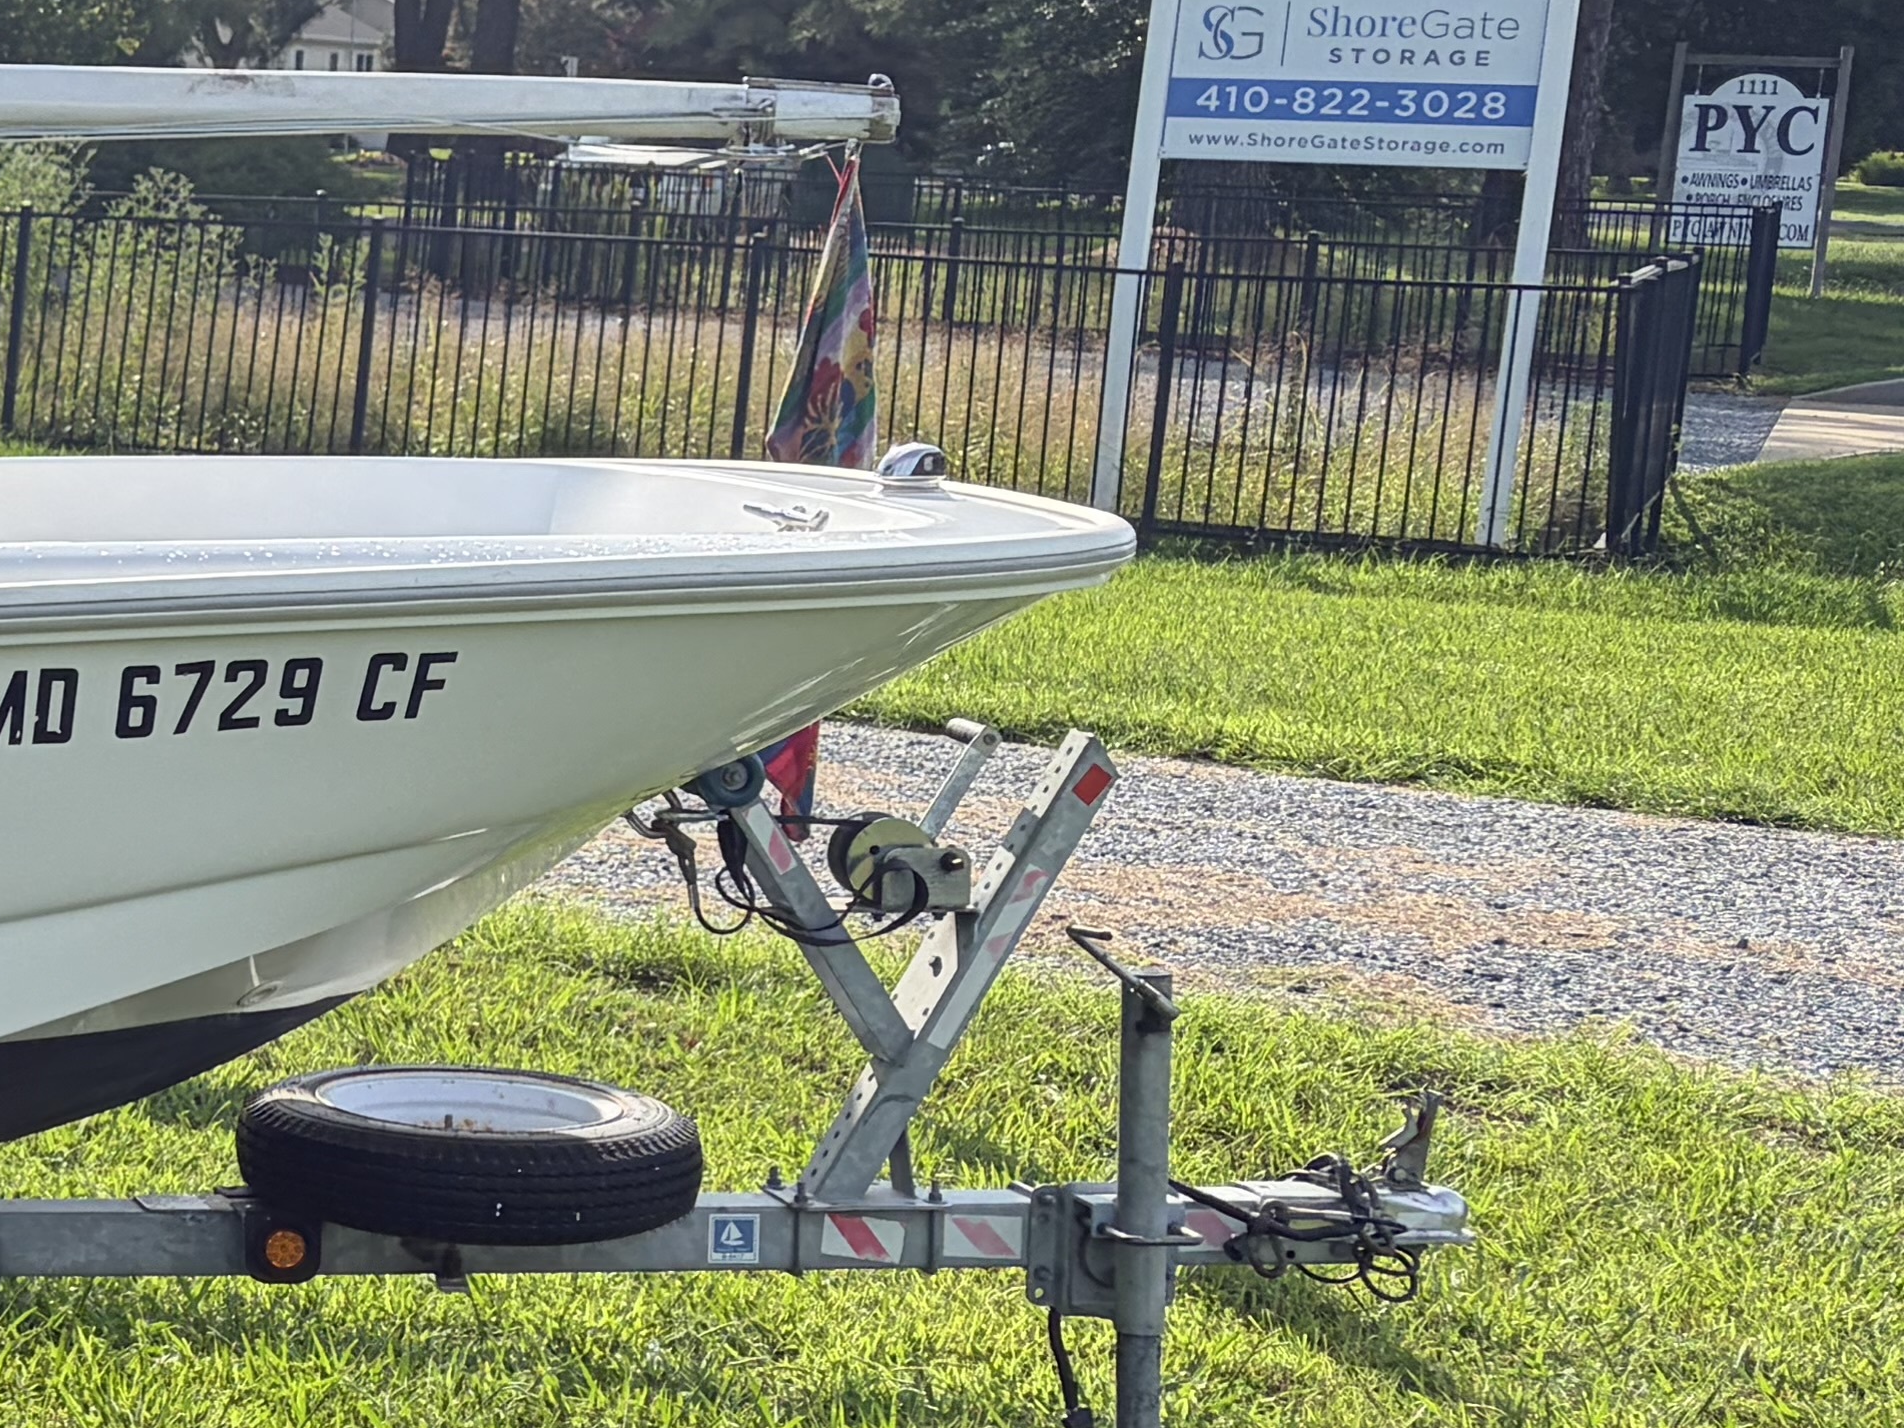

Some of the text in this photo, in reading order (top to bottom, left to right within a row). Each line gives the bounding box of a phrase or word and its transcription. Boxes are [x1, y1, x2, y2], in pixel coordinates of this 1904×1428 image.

[1306, 5, 1520, 41] ShoreGate
[1328, 47, 1491, 67] STORAGE
[1737, 79, 1779, 95] 1111
[1195, 85, 1507, 120] 410-822-3028
[1688, 103, 1820, 156] PYC
[1188, 132, 1505, 156] www.ShoreGateStorage.com
[1690, 172, 1813, 192] AWNINGS UMBRELLAS
[1738, 193, 1803, 211] ENCLORES
[114, 657, 324, 739] 6729
[356, 651, 459, 722] CF
